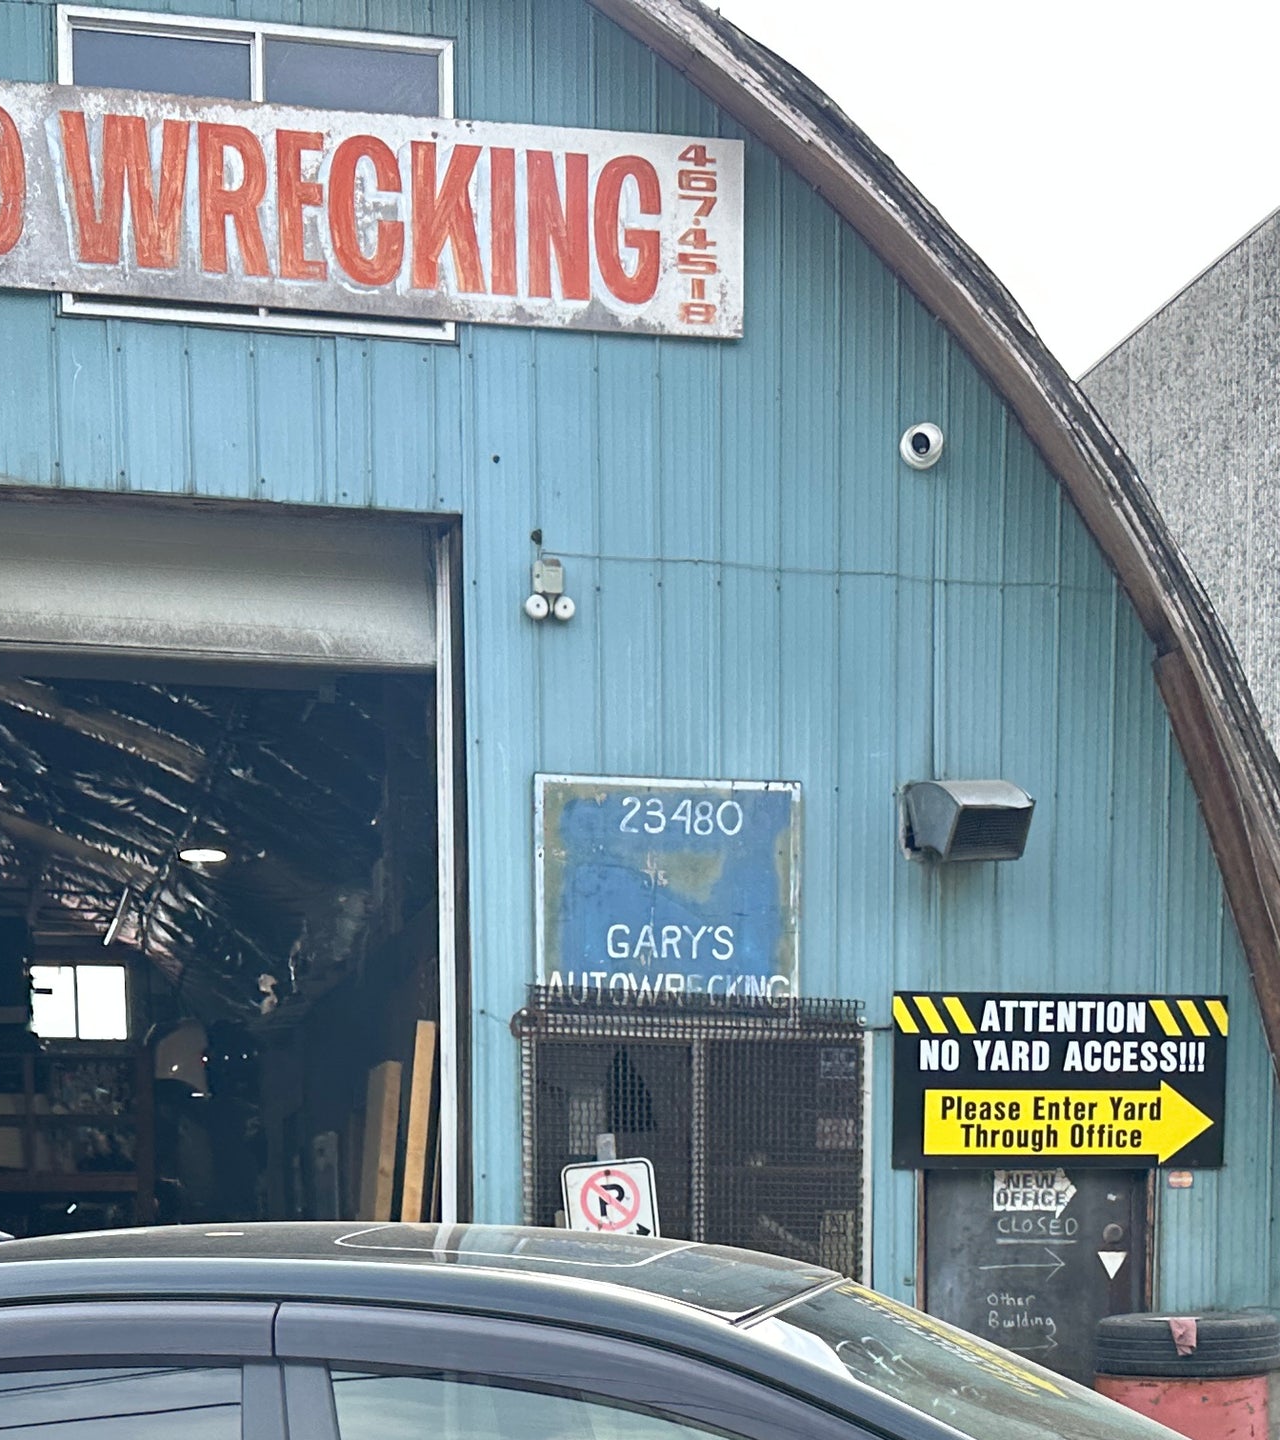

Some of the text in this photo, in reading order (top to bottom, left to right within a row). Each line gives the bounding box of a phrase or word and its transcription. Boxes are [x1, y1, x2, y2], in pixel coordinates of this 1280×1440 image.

[59, 109, 662, 306] WRECKING
[619, 796, 744, 835] 23480
[606, 924, 735, 960] GARY'S
[980, 1000, 1146, 1033] ATTENTION
[920, 1039, 1206, 1073] NO YARD ACCESS!!!
[941, 1096, 1162, 1121] Please Enter Yard
[960, 1123, 1143, 1151] Through Office
[1006, 1173, 1056, 1189] NEW
[996, 1189, 1067, 1207] OFFICE
[997, 1215, 1079, 1236] CLOSED
[986, 1292, 1037, 1307] Other
[988, 1310, 1057, 1337] Building
